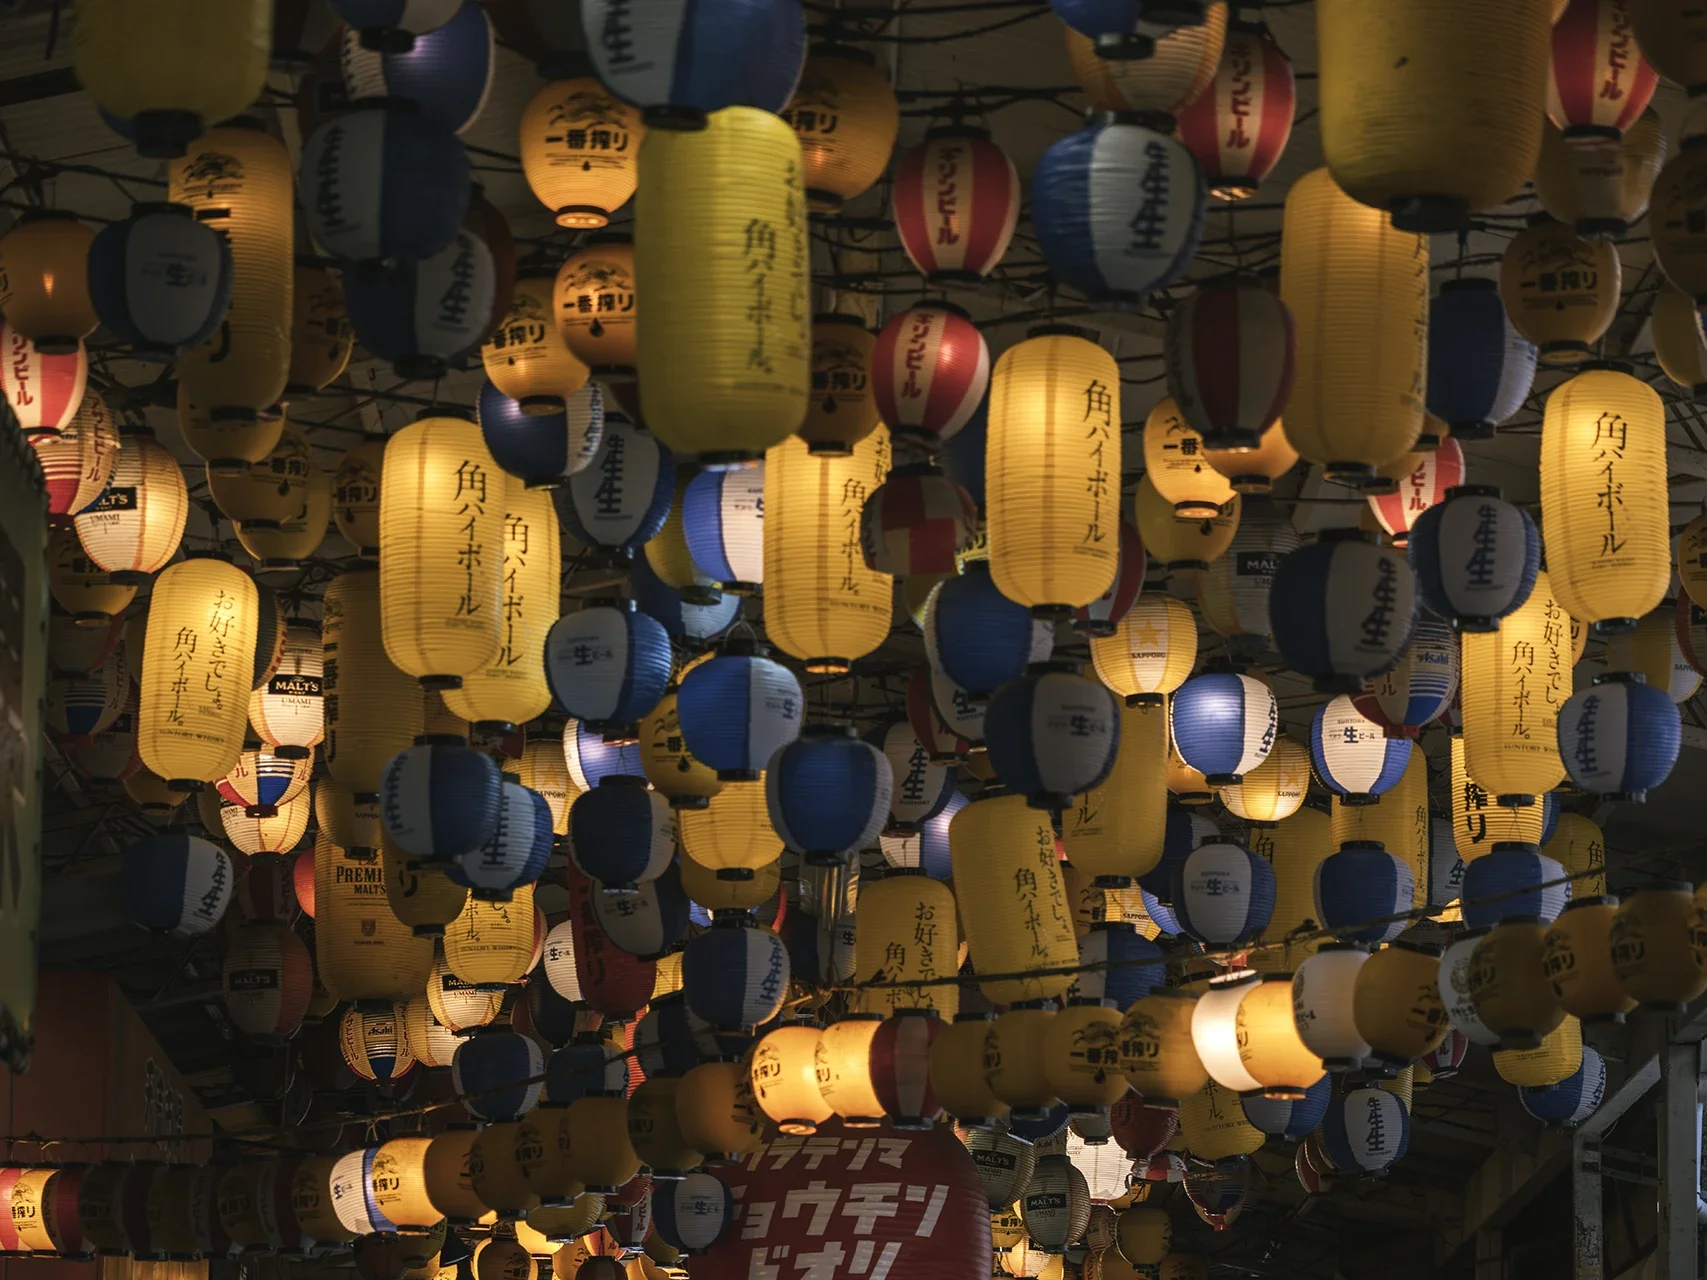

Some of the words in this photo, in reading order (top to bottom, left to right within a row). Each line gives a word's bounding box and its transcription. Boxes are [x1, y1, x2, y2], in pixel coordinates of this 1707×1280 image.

[545, 129, 628, 151] 一番搾り
[937, 147, 964, 245] キリンビール
[1520, 270, 1597, 293] 一番搾り
[562, 293, 634, 314] 一番搾り
[486, 324, 545, 348] 番搾り
[12, 329, 34, 406] リンビール
[902, 313, 935, 400] キリンビール
[811, 371, 867, 391] 番搾り
[593, 433, 625, 513] 生生生
[1083, 379, 1112, 544] 角ハイボール
[332, 486, 378, 503] 番搾り
[1592, 411, 1627, 556] 角ハイボール
[453, 459, 488, 617] 角ハイボール
[1464, 504, 1498, 585] 生生生
[1359, 555, 1398, 648] 生生生
[1131, 651, 1167, 660] SAPPORO
[1543, 599, 1564, 715] お好きでしょ
[166, 626, 199, 727] 角ハイボール。
[274, 681, 320, 694] MALT'S
[1511, 640, 1536, 740] 角ハイボール。
[1575, 695, 1601, 773] 生生生
[336, 866, 384, 884] PREMI
[354, 884, 388, 896] MALT'S
[1013, 866, 1048, 960] 角ハイボール。
[913, 901, 939, 1011] お好きでしょ
[367, 1025, 393, 1037] Asahi
[753, 1063, 781, 1082] 番搾り
[1069, 1047, 1119, 1065] 一番搾
[1366, 1096, 1385, 1151] 生生生
[743, 1137, 912, 1171] ラテンマ
[976, 1155, 1010, 1167] MALT'S
[372, 1176, 400, 1192] 番搾り
[11, 1205, 36, 1218] 番搾り
[731, 1180, 950, 1241] ョウチン
[1030, 1196, 1061, 1208] MALT'S
